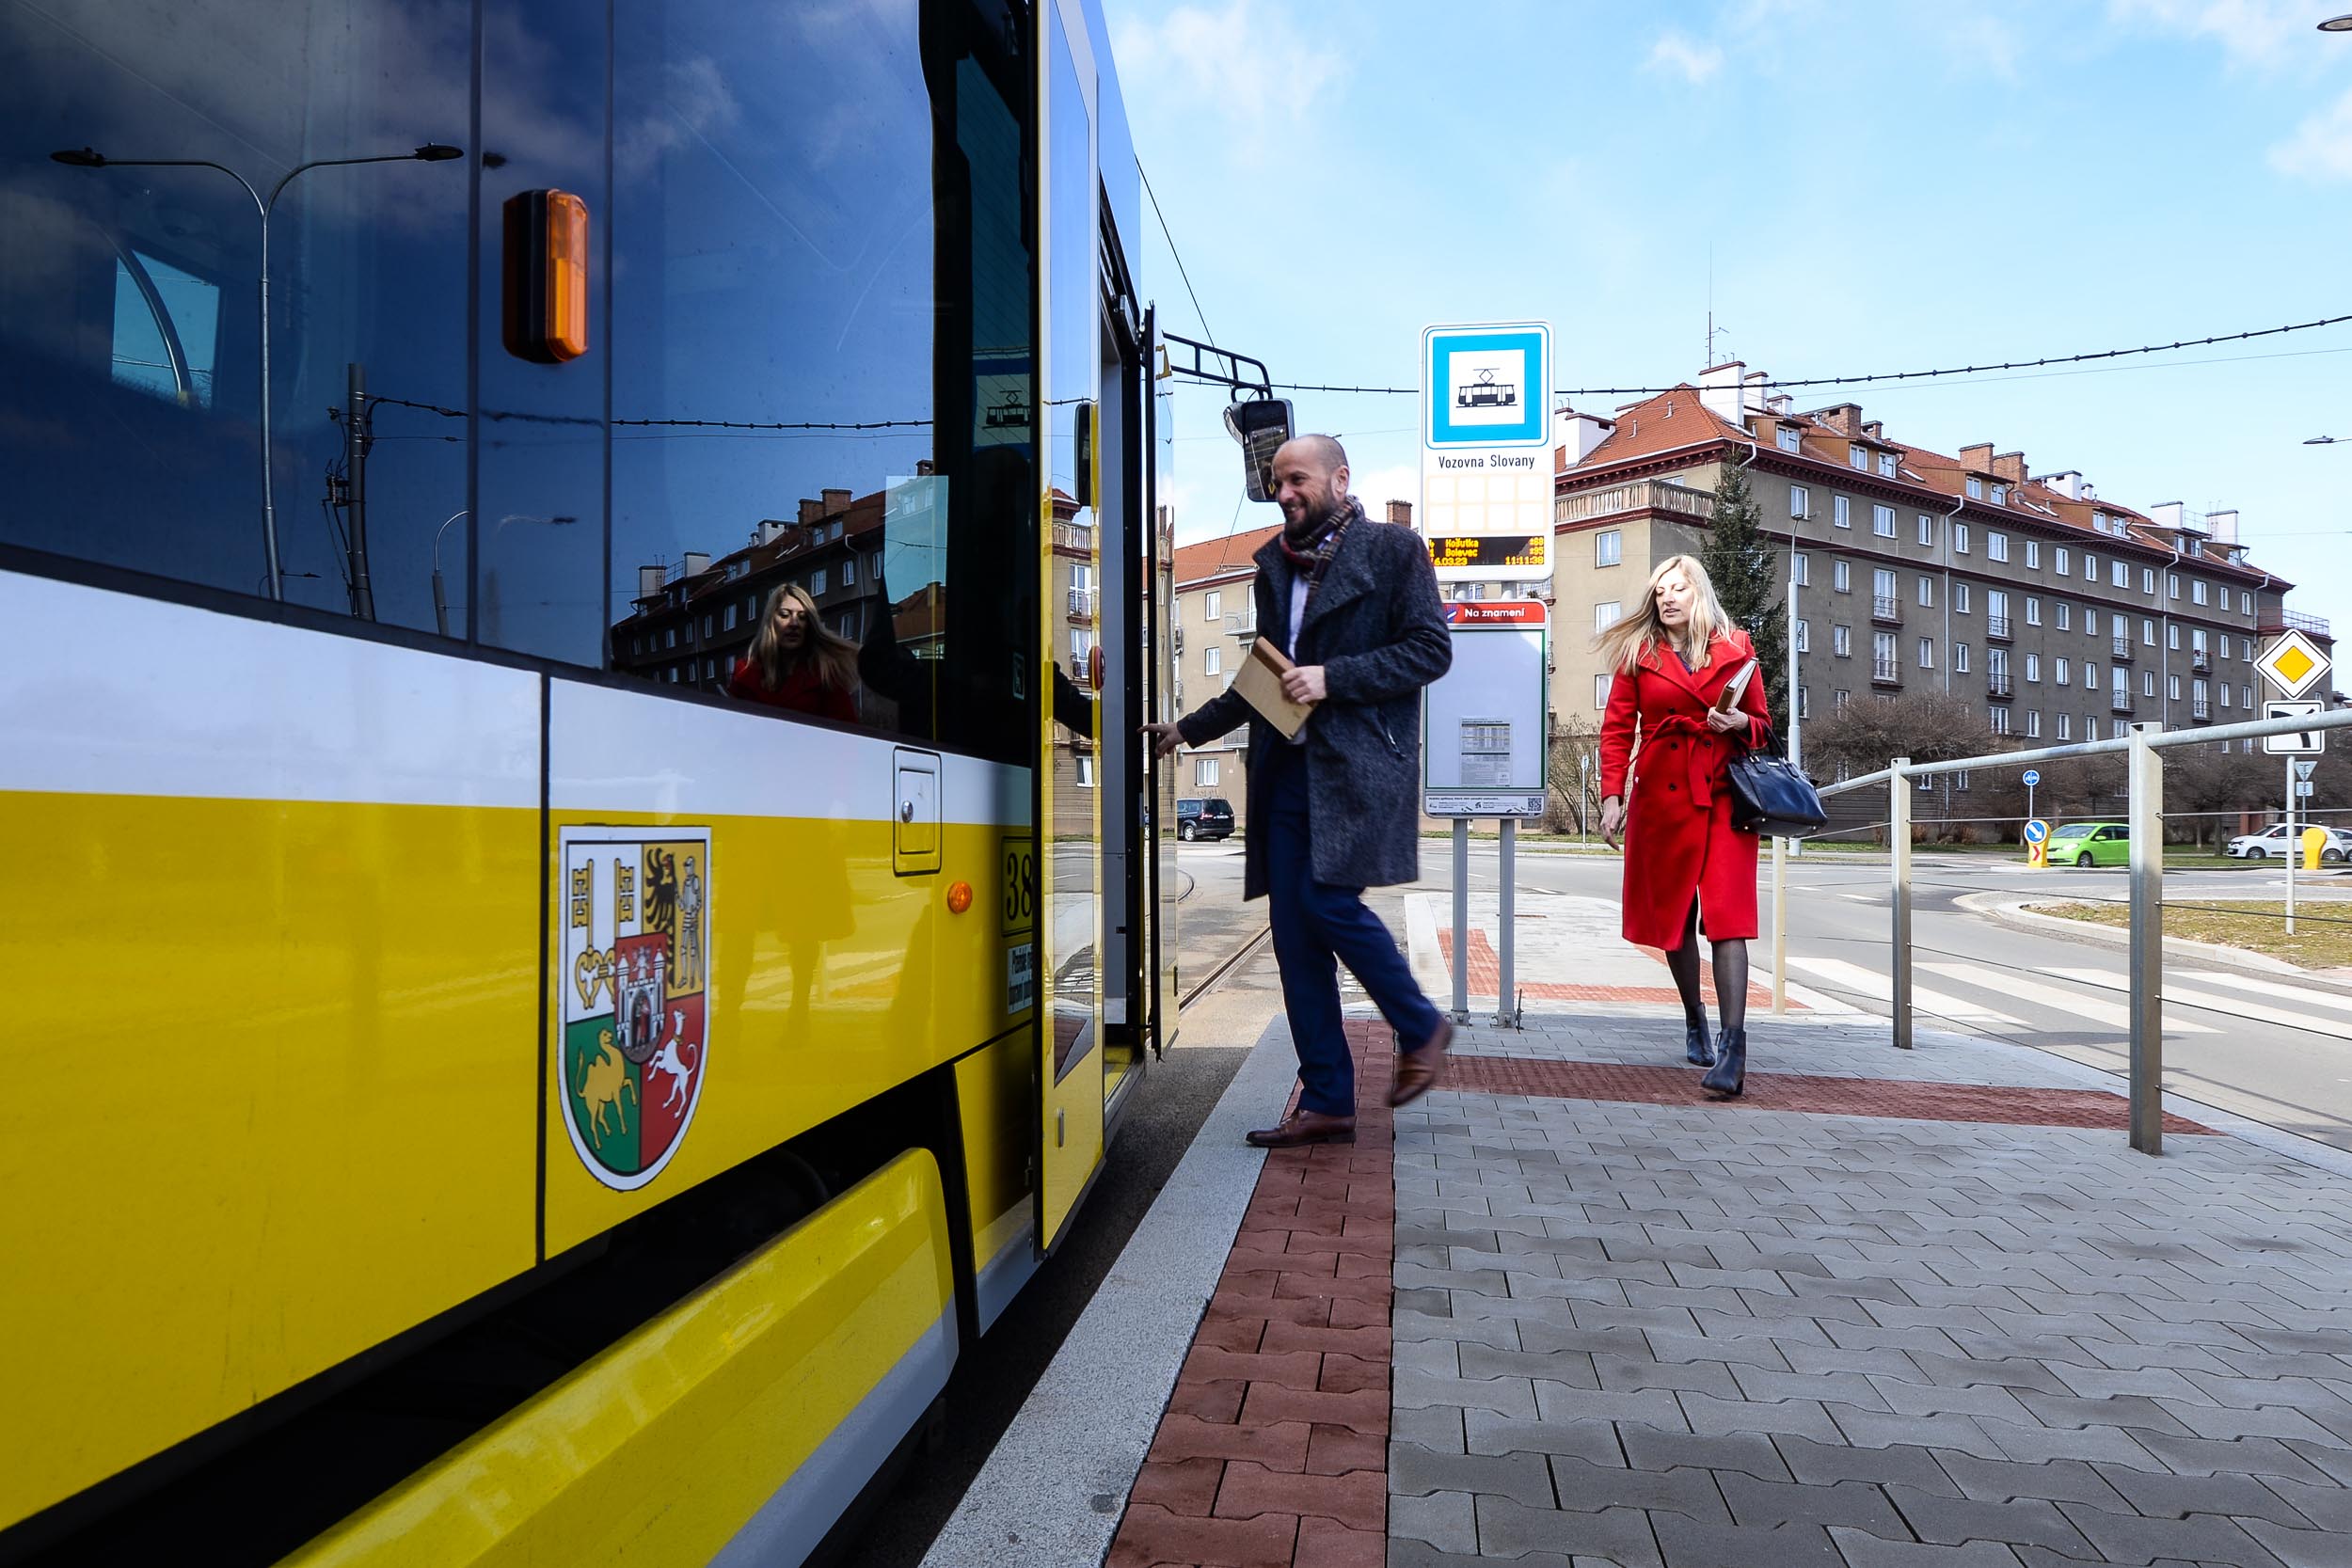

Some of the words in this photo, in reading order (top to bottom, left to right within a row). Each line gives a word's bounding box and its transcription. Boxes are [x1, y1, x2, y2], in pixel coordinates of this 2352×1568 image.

[1438, 456, 1484, 468] Vozovna
[1490, 454, 1534, 469] Slovany
[1445, 537, 1479, 547] Košutka
[1445, 547, 1478, 557] Bolevec
[1464, 608, 1480, 618] Na
[1482, 607, 1526, 618] znamení
